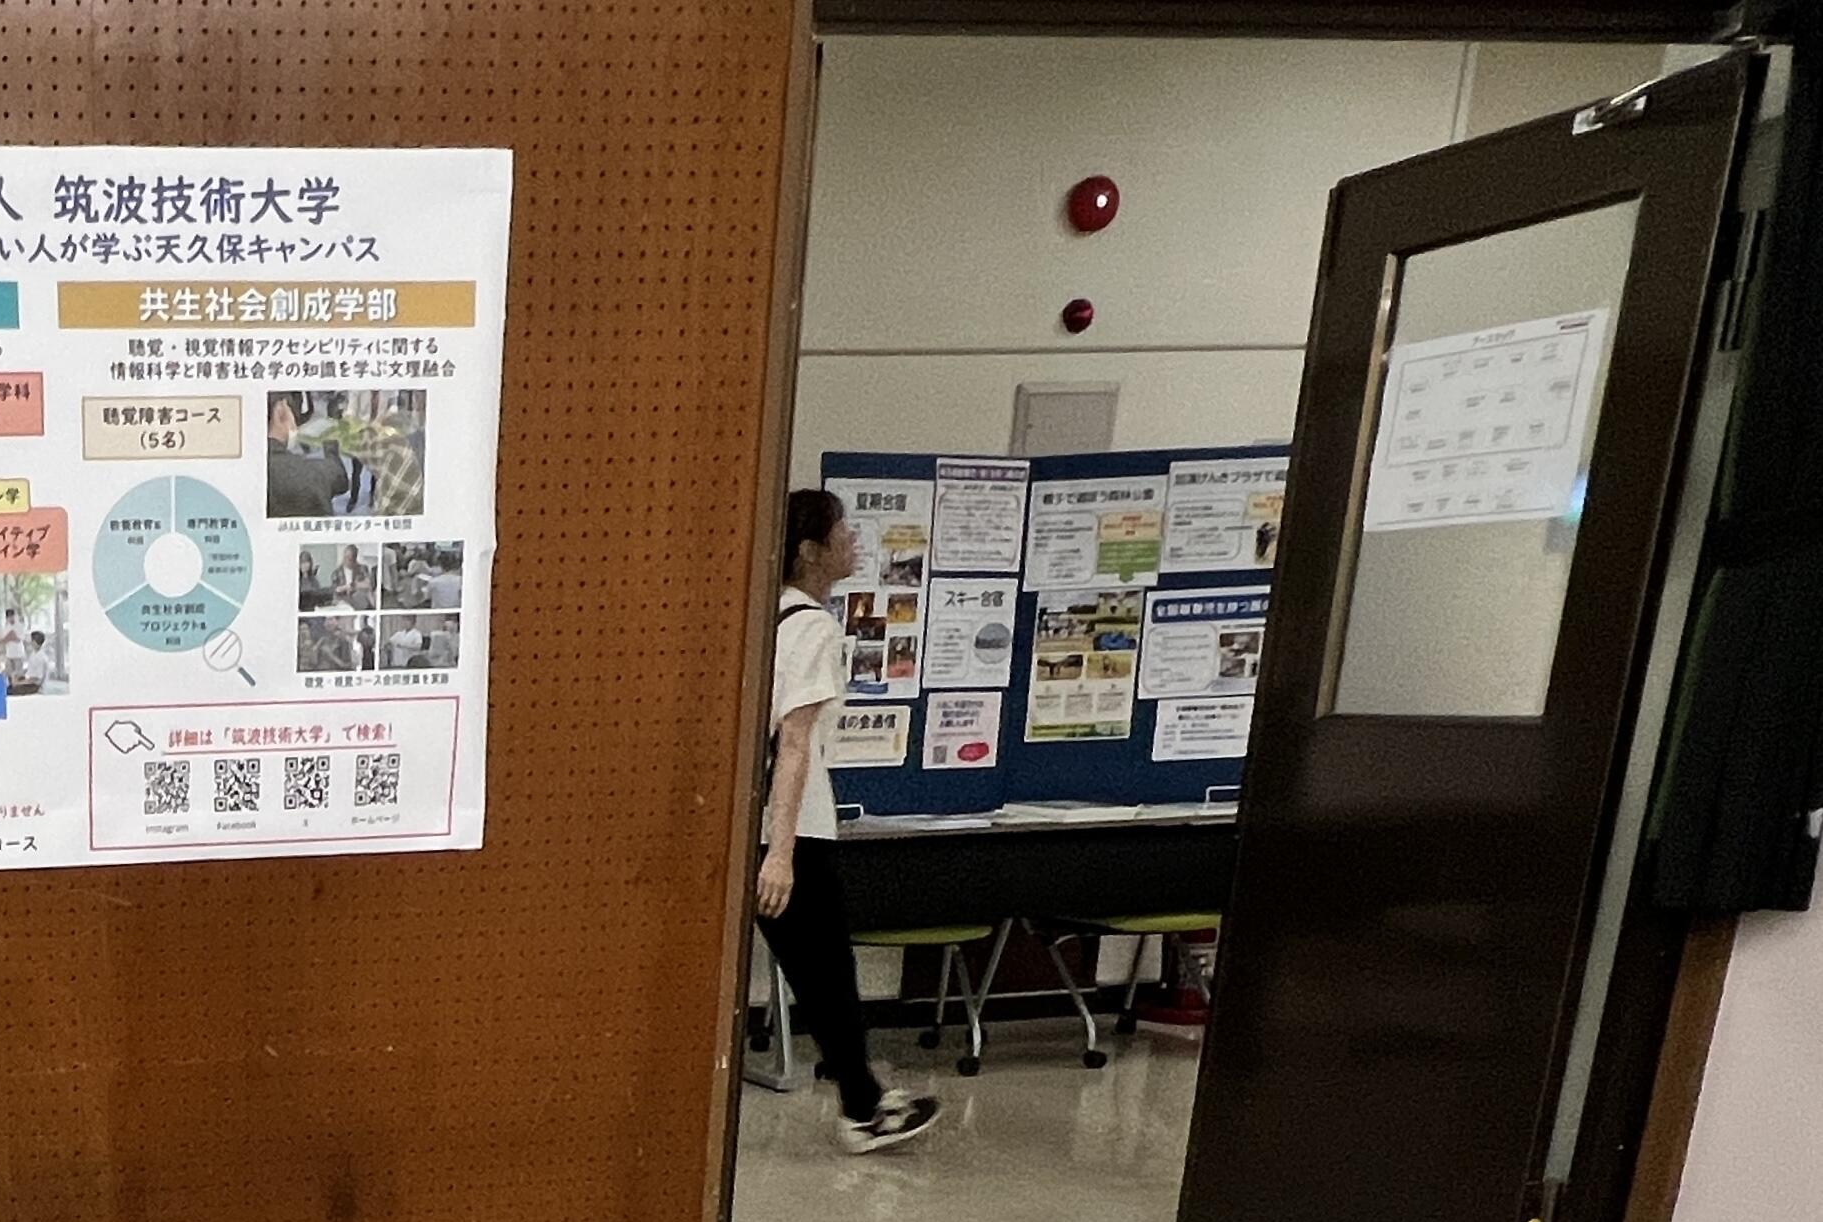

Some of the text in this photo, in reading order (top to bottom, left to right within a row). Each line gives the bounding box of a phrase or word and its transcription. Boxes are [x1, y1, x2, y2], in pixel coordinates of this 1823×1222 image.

[54, 174, 341, 223] 筑波技術大学
[139, 287, 398, 323] 共生社会創成学部
[128, 337, 438, 358] 聴覚・視覚情報アクセシビリティに関する
[109, 358, 457, 380] 情報科学と障害社会学の知識を学ぶ文理融合
[103, 407, 222, 426] 聴覚障害コース
[140, 430, 185, 450] (5名)
